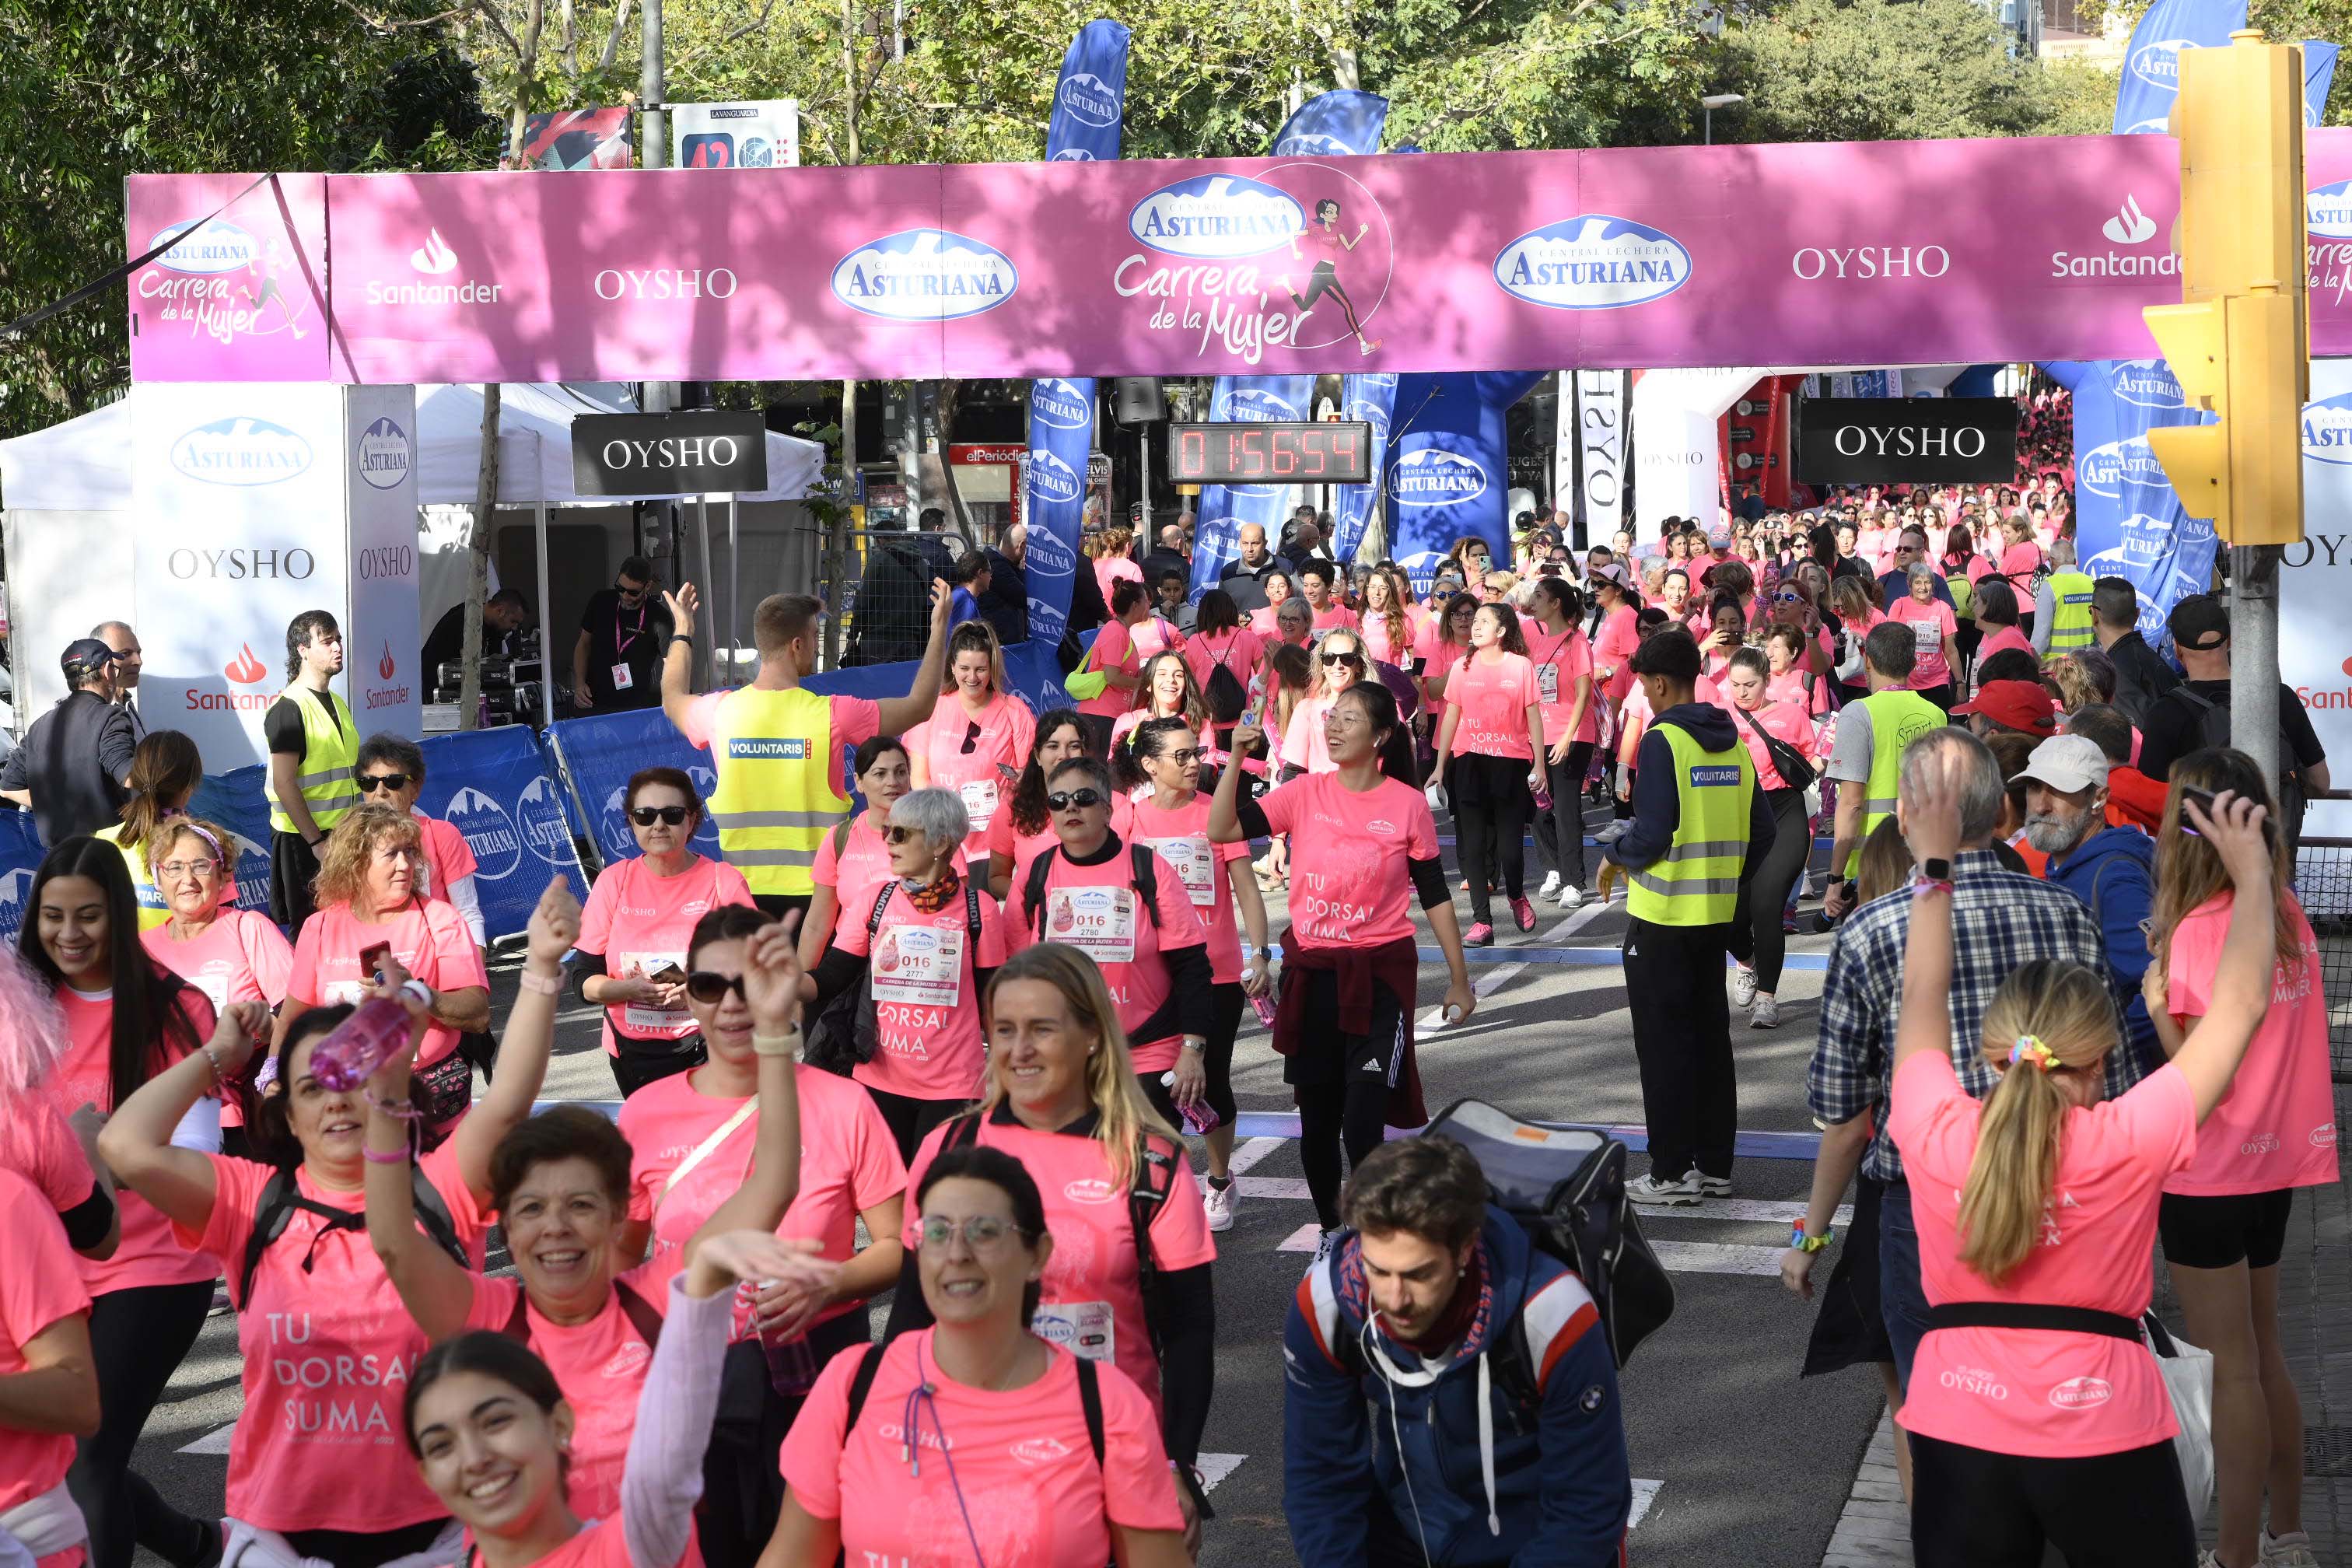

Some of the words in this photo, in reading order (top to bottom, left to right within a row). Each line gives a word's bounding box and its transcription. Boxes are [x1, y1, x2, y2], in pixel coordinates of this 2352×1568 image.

[1142, 205, 1292, 238] ASTURIANA
[1539, 247, 1599, 257] CENTRAL
[1607, 246, 1670, 256] LECHERA
[1792, 245, 1951, 280] OYSHO
[846, 263, 1004, 296] ASTURIANA
[1114, 254, 1258, 297] Carrera
[1509, 250, 1677, 286] ASTURIANA
[138, 270, 229, 299] Carrera
[366, 279, 502, 305] Santander
[594, 268, 737, 300] OYSHO
[161, 300, 177, 320] de
[182, 302, 194, 320] la
[191, 298, 265, 345] Mujer
[1149, 299, 1177, 330] de
[1182, 299, 1201, 329] la
[1197, 292, 1314, 365] Mujer
[603, 436, 737, 470] OYSHO
[1835, 425, 1986, 457] OYSHO
[184, 443, 303, 468] ASTURIANA
[362, 445, 407, 471] ASTURIANA
[966, 448, 1020, 462] elPeriódi
[1391, 472, 1479, 494] ASTURIANA
[168, 548, 315, 580] OYSHO
[359, 544, 411, 580] OYSHO
[2280, 534, 2352, 568] OY
[366, 684, 410, 710] Santander
[1468, 718, 1479, 729] TU
[730, 743, 803, 754] VOLUNTARIS
[938, 773, 953, 786] TU
[1692, 771, 1739, 782] VOLUNTARIS
[1173, 863, 1189, 873] 16
[1306, 873, 1325, 891] TU
[621, 906, 656, 916] OYSHO
[1076, 915, 1106, 926] 016
[903, 938, 933, 947] ASTURIANA
[902, 956, 931, 968] 016
[631, 1013, 653, 1021] OYSHO
[266, 1312, 310, 1345] TU
[1941, 1370, 2008, 1401] OYSHO
[285, 1399, 390, 1432] SUMA
